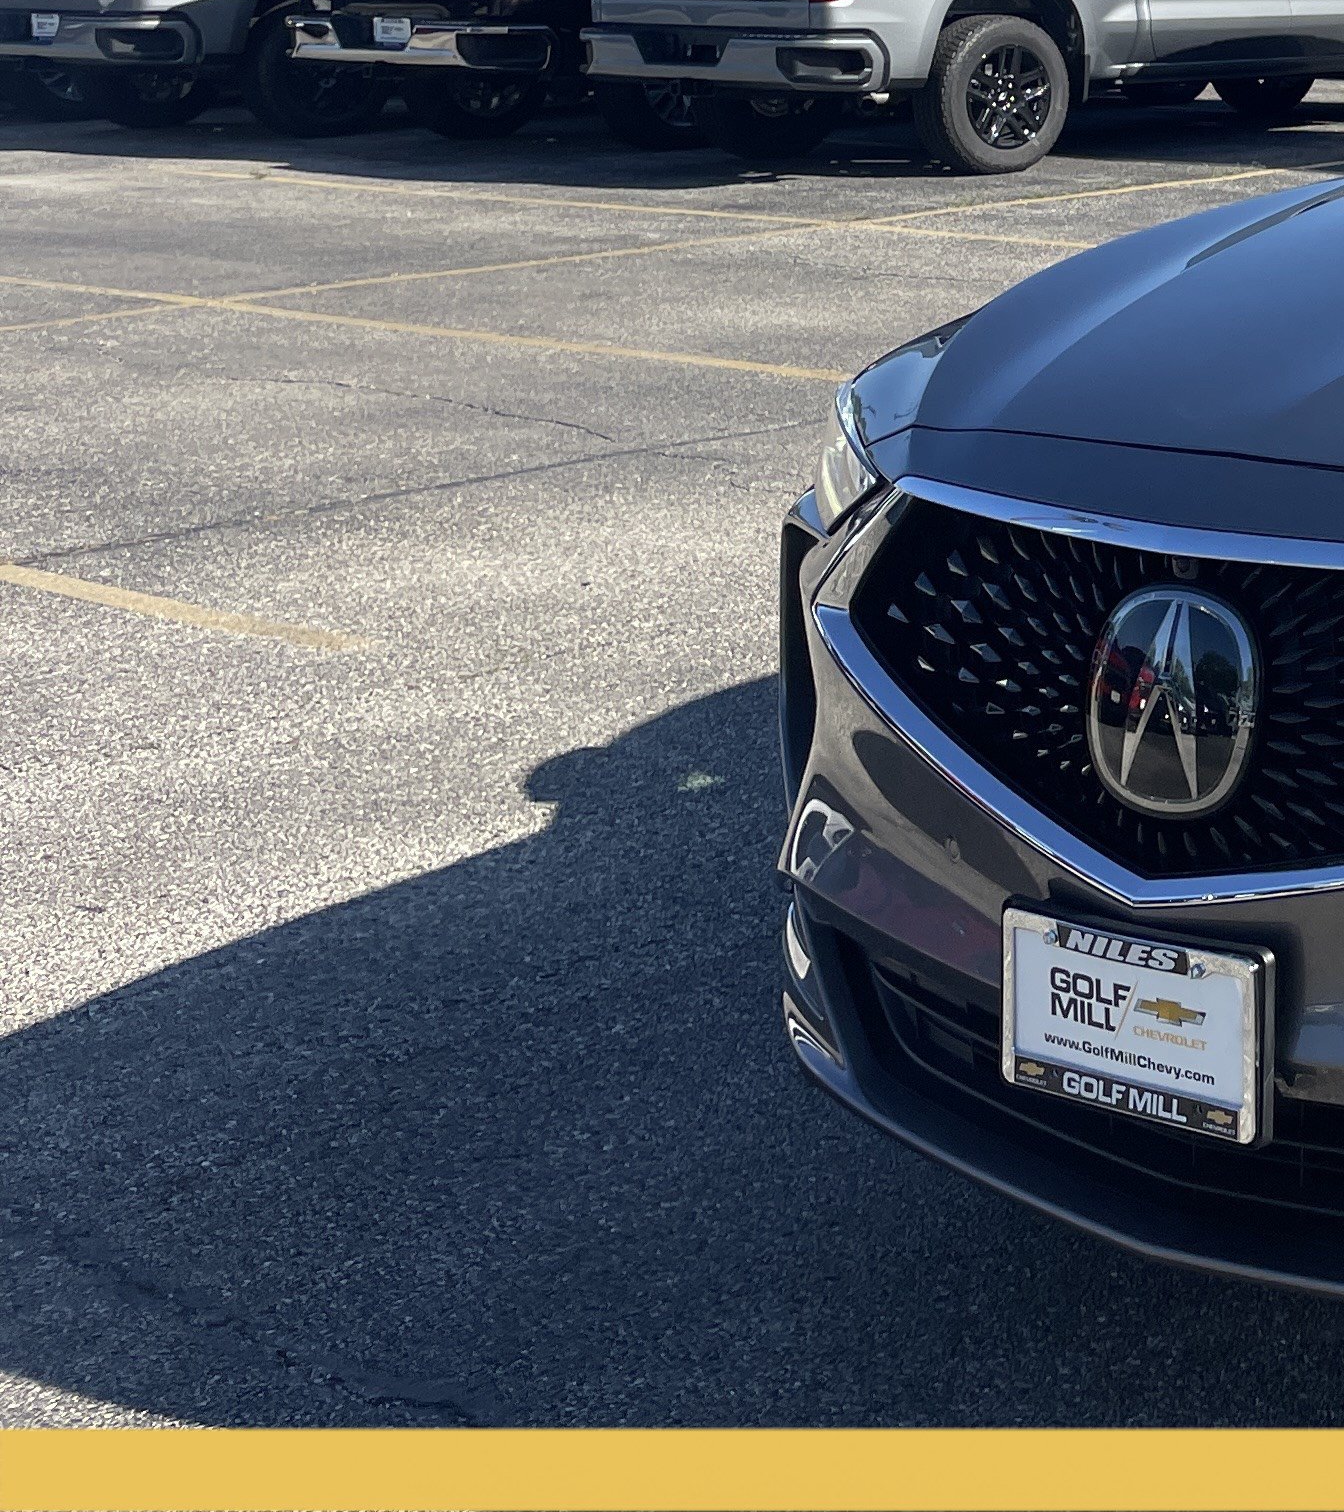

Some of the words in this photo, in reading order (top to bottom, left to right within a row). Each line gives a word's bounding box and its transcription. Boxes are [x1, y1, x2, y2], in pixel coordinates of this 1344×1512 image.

[1065, 928, 1179, 971] NILES
[1050, 966, 1131, 1008] GOLF
[1050, 991, 1117, 1032] MILL
[1044, 1032, 1216, 1086] www.GolfMillChevy.com
[1132, 1026, 1208, 1052] CHEVROLET
[1062, 1071, 1127, 1106] GOLF
[1128, 1088, 1188, 1124] MILL
